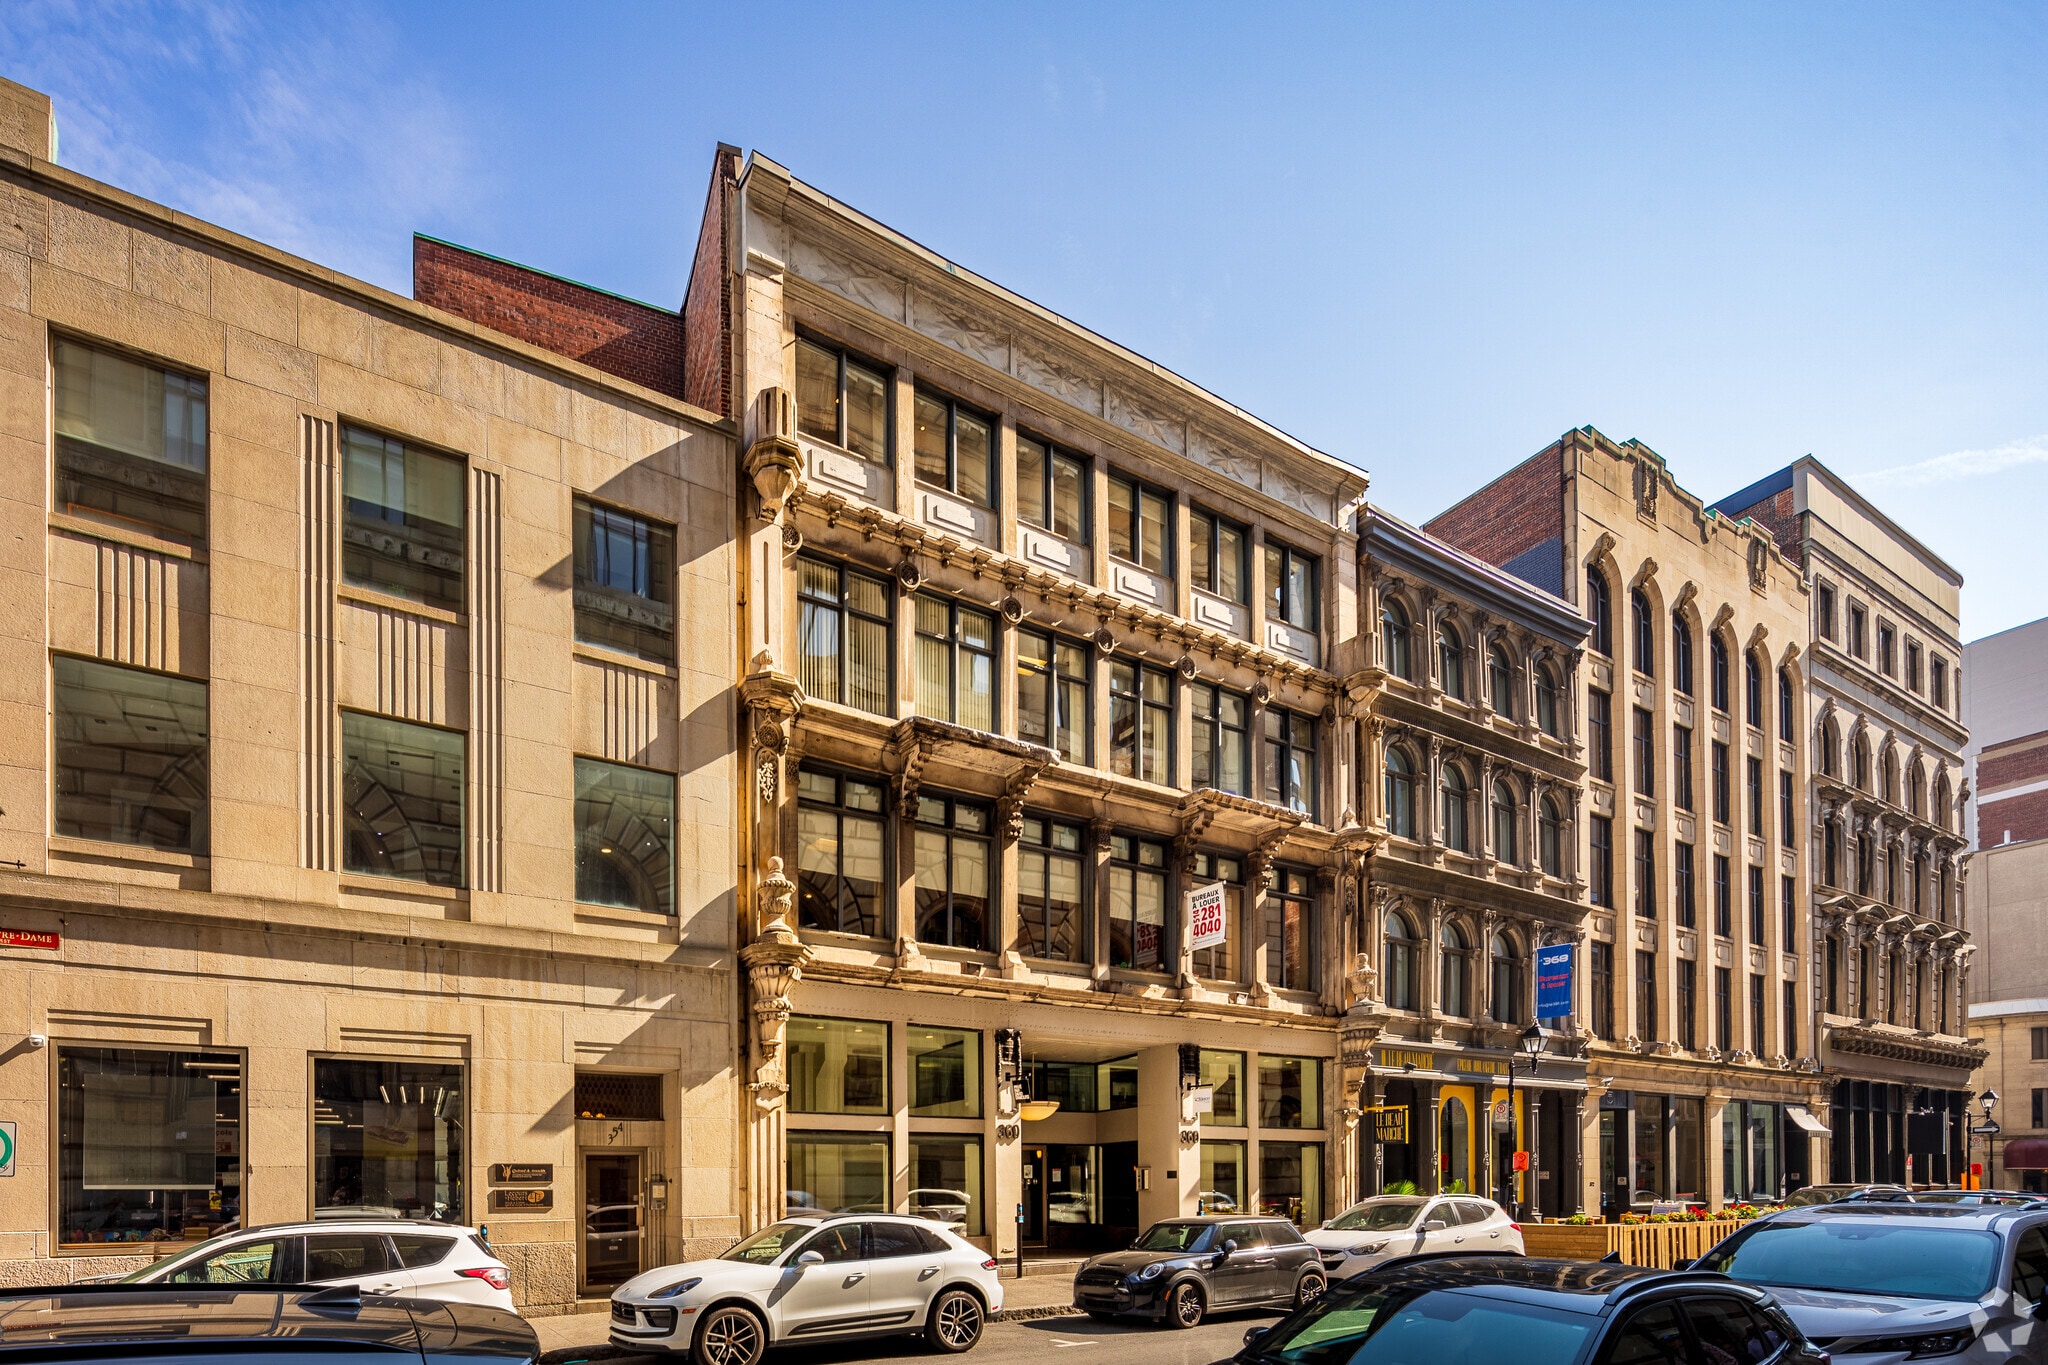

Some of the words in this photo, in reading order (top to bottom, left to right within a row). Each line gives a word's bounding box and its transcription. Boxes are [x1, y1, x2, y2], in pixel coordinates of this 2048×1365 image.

[1192, 889, 1219, 903] BUREAUX
[1200, 896, 1220, 907] LOUER
[1201, 903, 1221, 921] 281
[1193, 918, 1222, 937] 4040
[1376, 1113, 1384, 1127] LE
[1385, 1112, 1403, 1126] BEAU
[608, 1122, 623, 1146] 354
[996, 1124, 1020, 1140] 360
